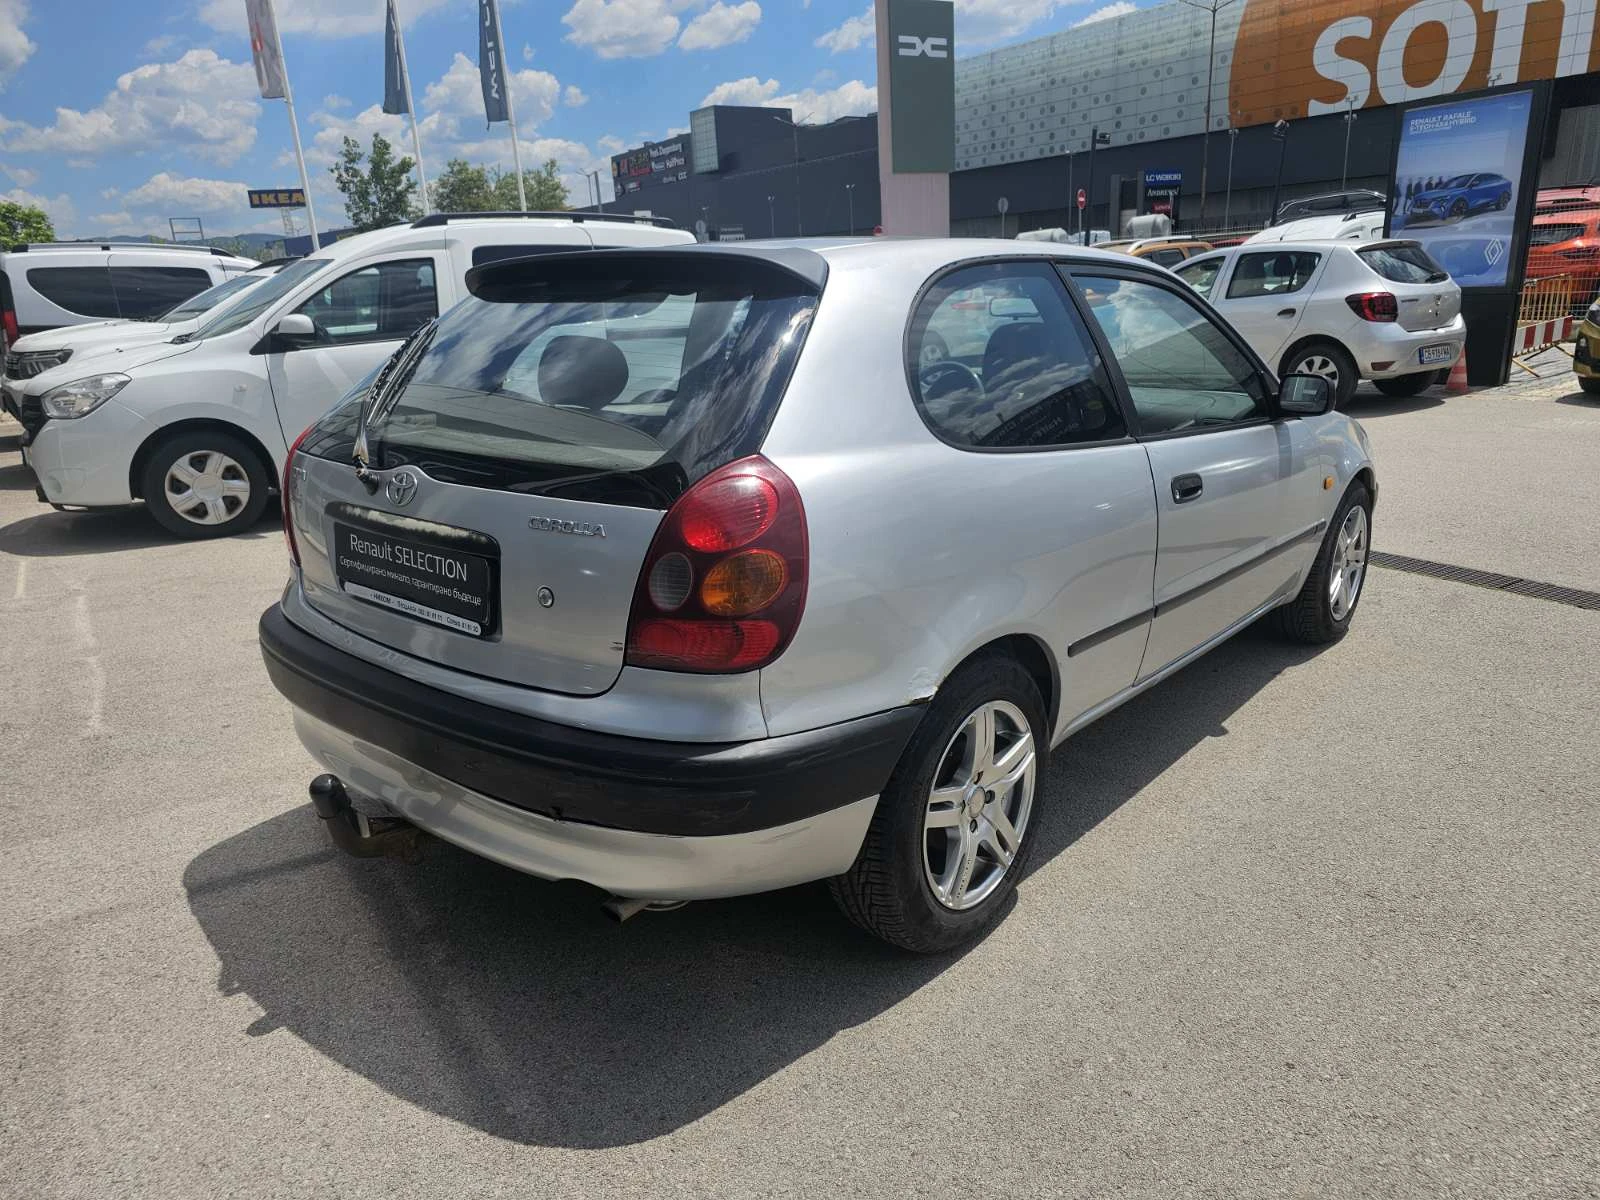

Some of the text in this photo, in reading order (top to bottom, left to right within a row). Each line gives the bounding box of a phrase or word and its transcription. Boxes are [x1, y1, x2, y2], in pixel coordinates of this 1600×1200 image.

[251, 192, 305, 205] IKEA
[528, 515, 606, 537] COROLLA
[350, 534, 468, 582] Renault SELECTION
